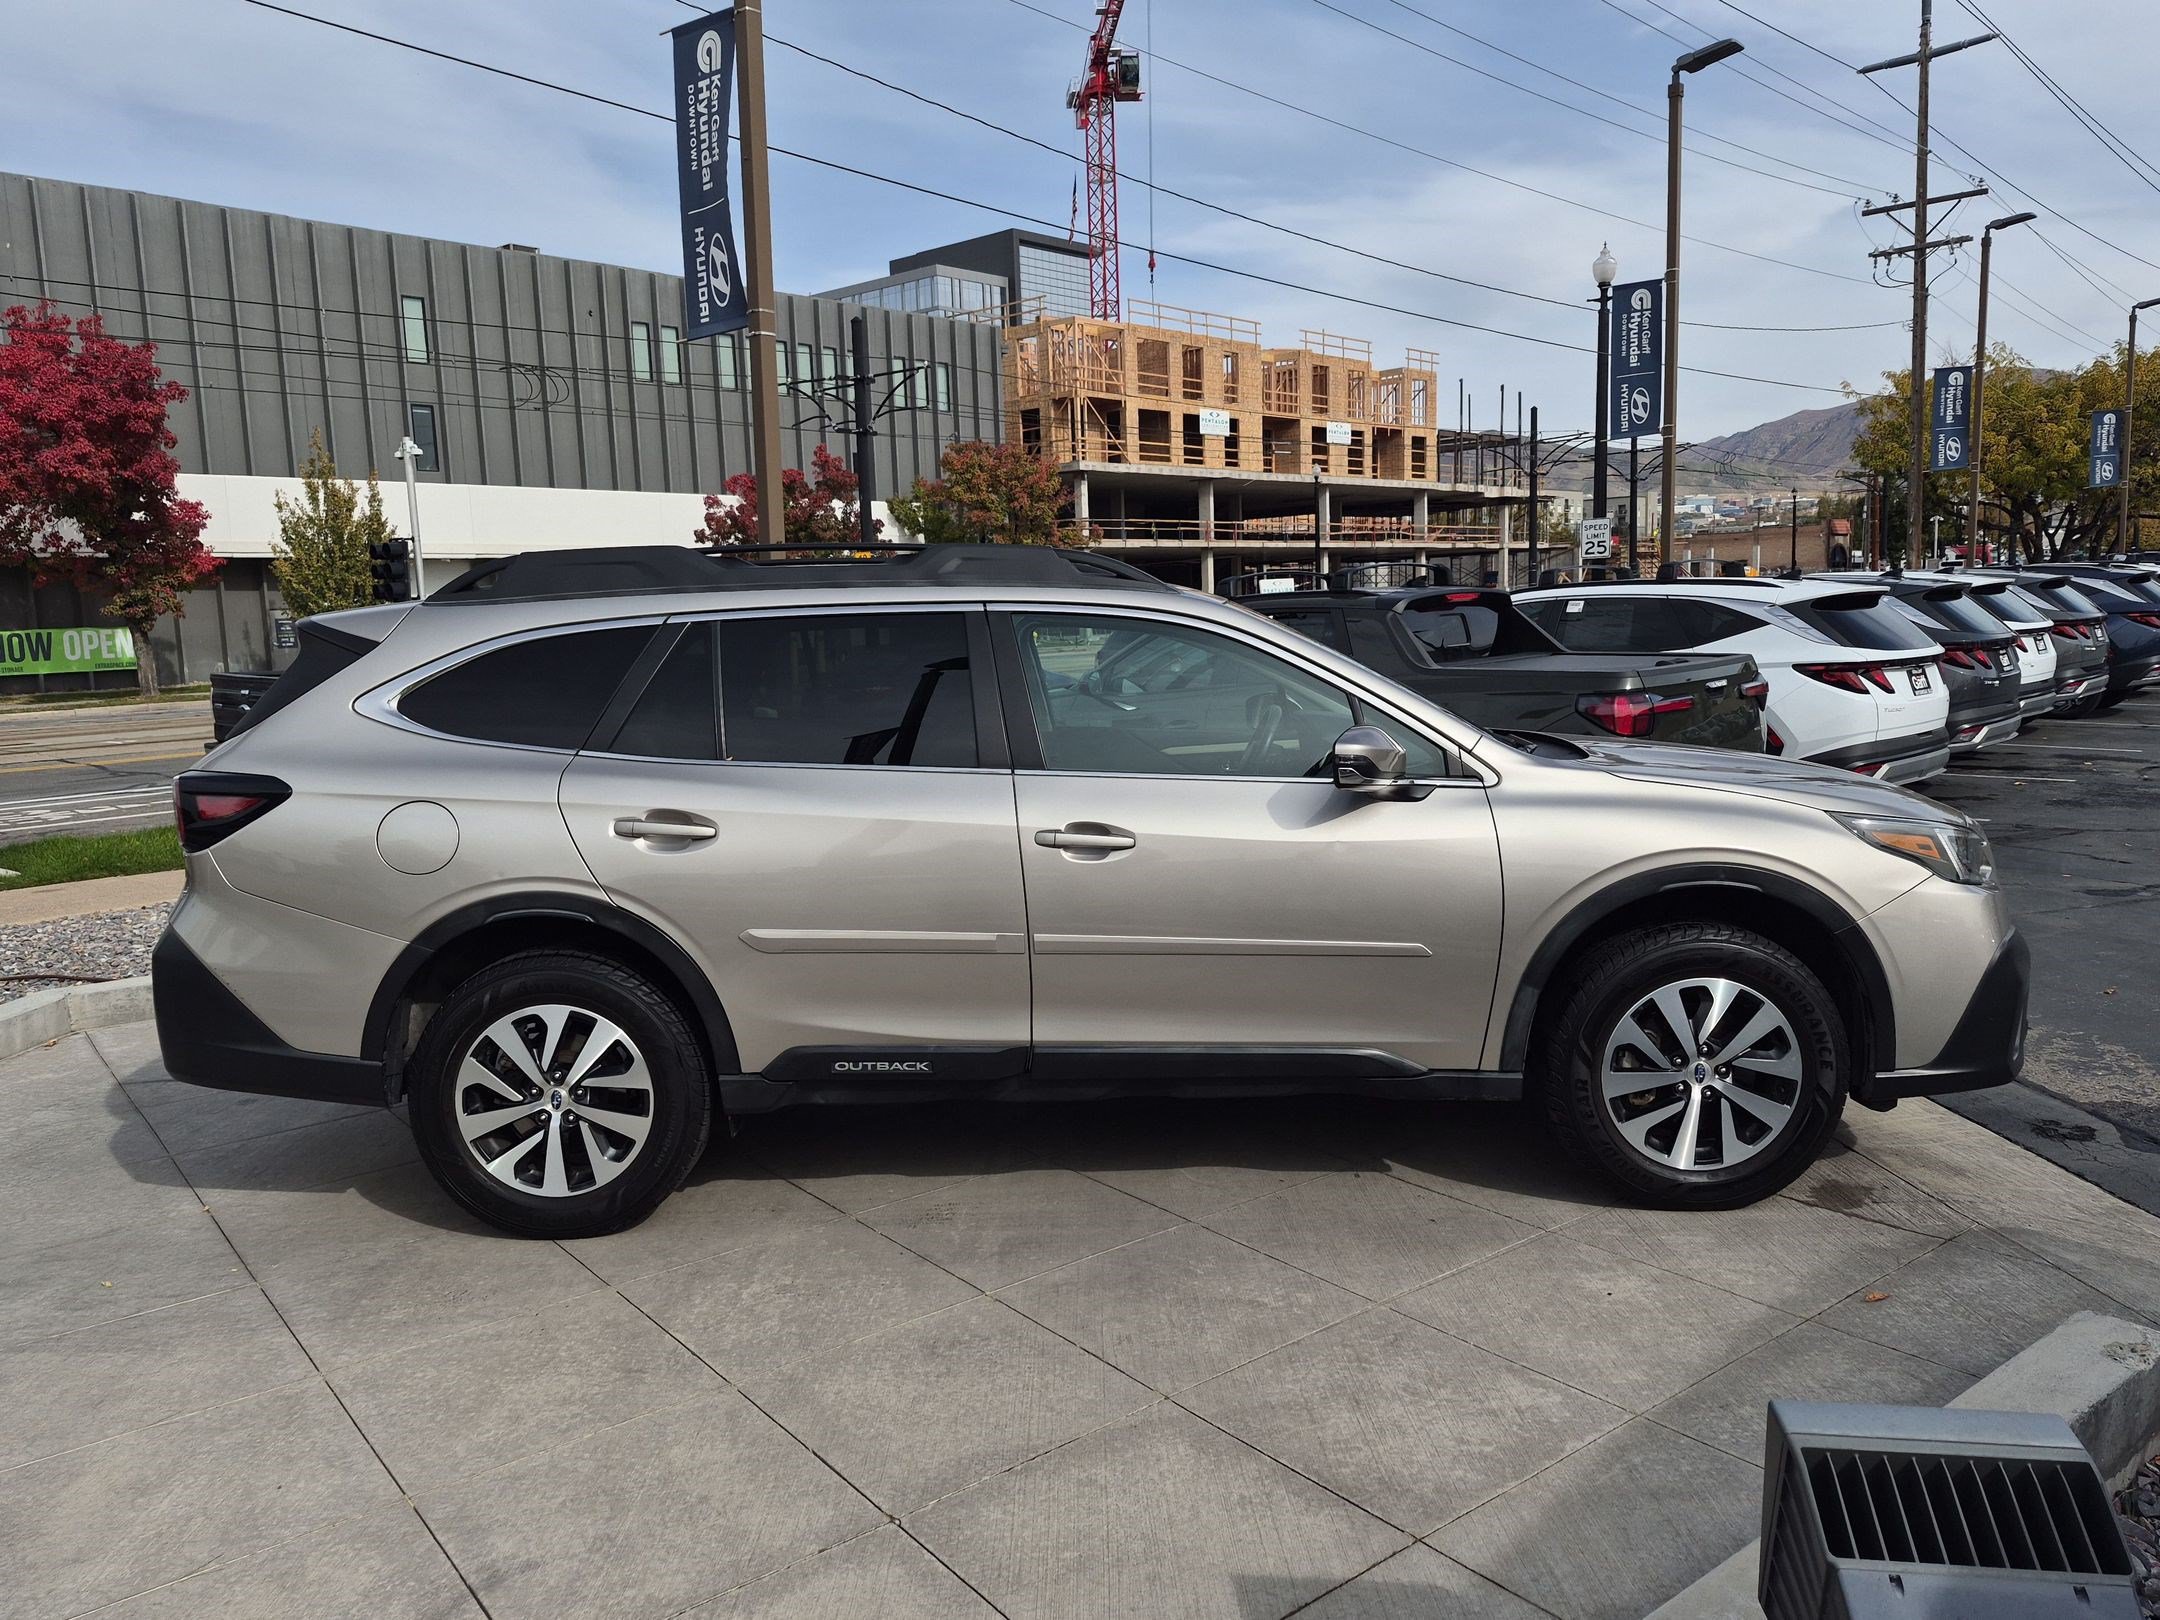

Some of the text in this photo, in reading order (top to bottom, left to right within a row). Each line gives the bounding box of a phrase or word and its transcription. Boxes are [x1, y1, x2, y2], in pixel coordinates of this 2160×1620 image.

[711, 73, 720, 113] Ken
[688, 84, 698, 171] DOWNTOWN
[697, 78, 713, 191] Hyundai
[694, 226, 710, 324] HYUNDAI
[1629, 311, 1641, 367] Hyundai
[1641, 310, 1652, 354] Ken Garff
[1620, 384, 1629, 432] HYUNDAI
[1945, 386, 1956, 424] Hyundai
[1955, 386, 1964, 400] Ken
[1938, 434, 1946, 467] HYUNDAI
[2101, 424, 2110, 452] Hyundai
[1583, 523, 1609, 531] SPEED
[1586, 532, 1606, 540] LIMIT
[1584, 540, 1607, 555] 25
[62, 629, 136, 661] OPEN
[834, 1061, 930, 1071] OUTBACK
